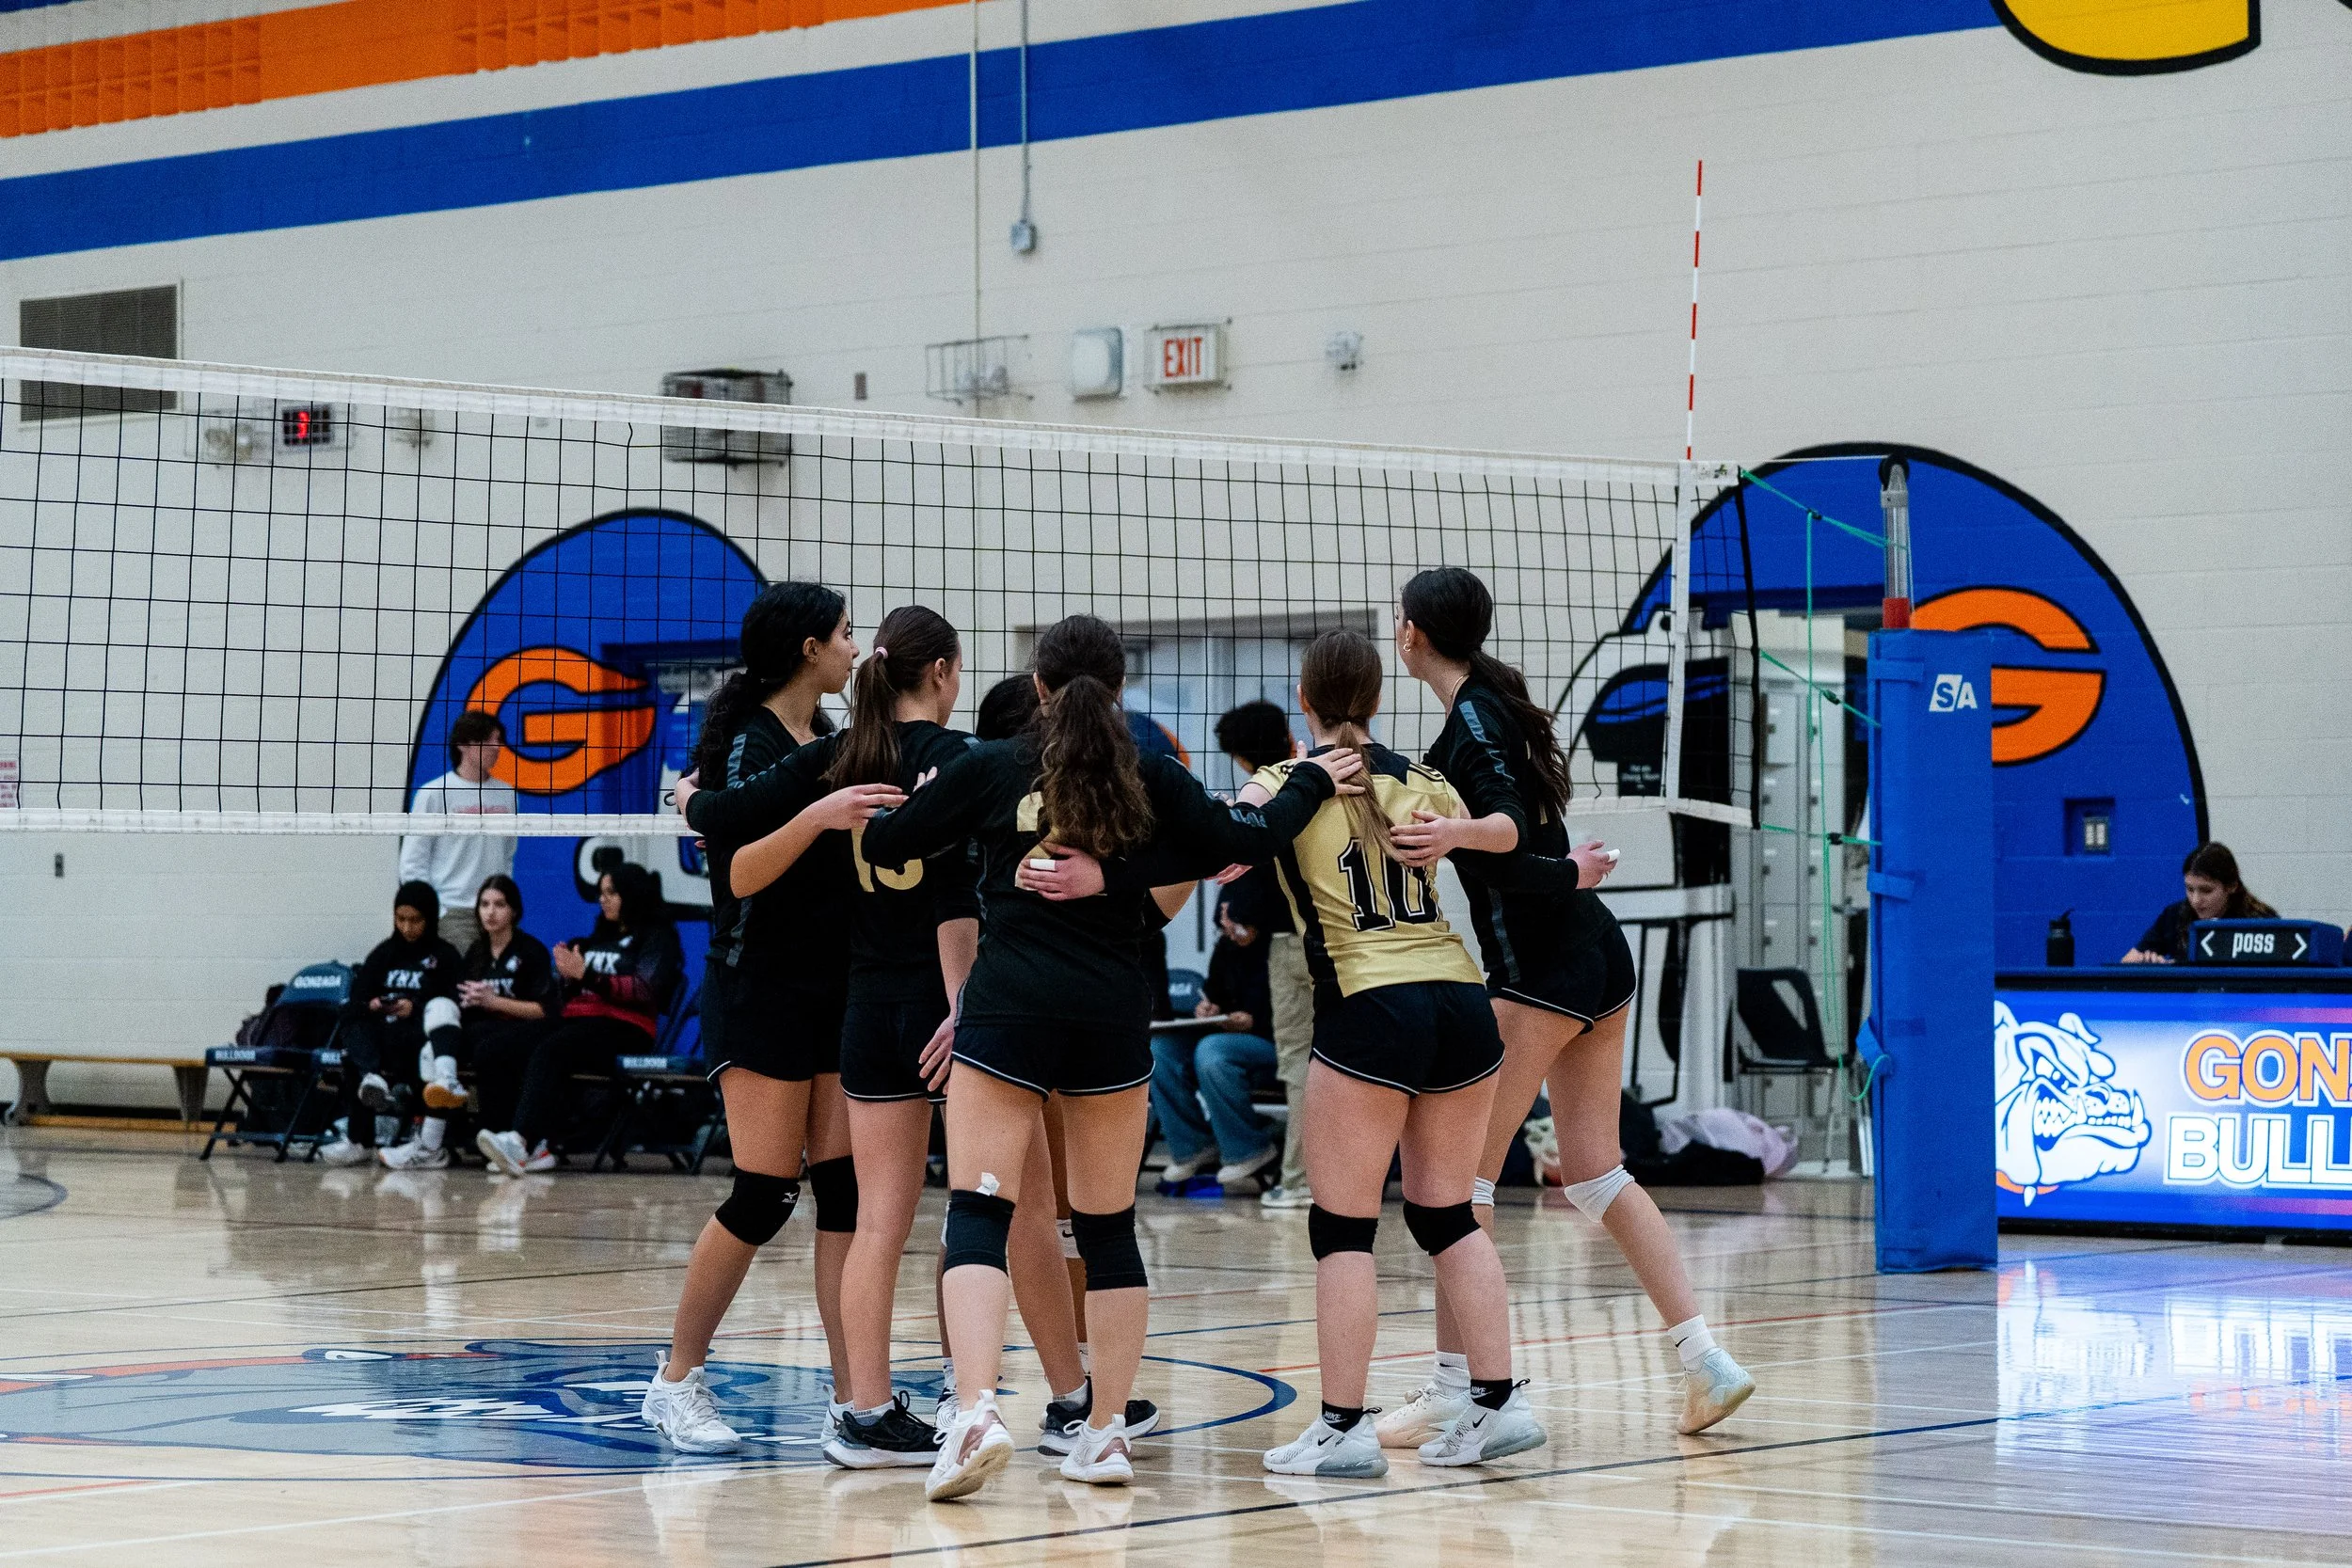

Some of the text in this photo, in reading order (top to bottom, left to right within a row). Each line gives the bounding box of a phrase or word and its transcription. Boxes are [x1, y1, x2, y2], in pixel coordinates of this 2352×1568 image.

[1163, 336, 1203, 377] EXIT
[1929, 673, 1979, 712] SA
[1337, 837, 1439, 932] 10
[2182, 1030, 2352, 1107] GON
[2168, 1115, 2352, 1185] BULL
[1325, 1411, 1341, 1420] NIKE
